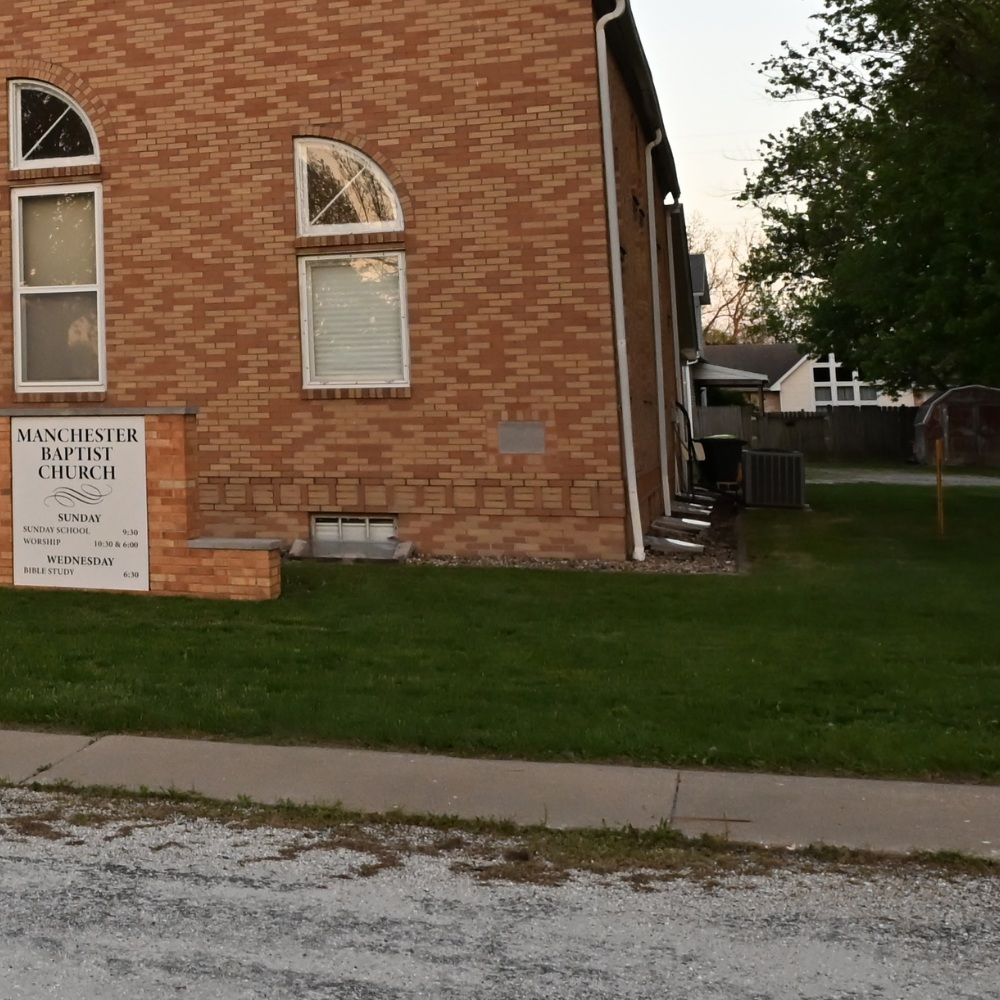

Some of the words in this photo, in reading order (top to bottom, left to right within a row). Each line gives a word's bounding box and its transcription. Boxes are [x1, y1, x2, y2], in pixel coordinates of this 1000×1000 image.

[17, 428, 138, 442] MANCHESTER
[42, 447, 113, 461] BAPTIST
[38, 465, 115, 480] CHURCH
[58, 513, 101, 523] SUNDAY
[23, 526, 54, 534] SUNDAY
[57, 527, 90, 535] SCHOOL
[24, 538, 61, 546] WORSHIP
[47, 555, 114, 566] WEDNESDAY
[24, 567, 46, 575] BIBLE
[48, 568, 74, 576] STUDY
